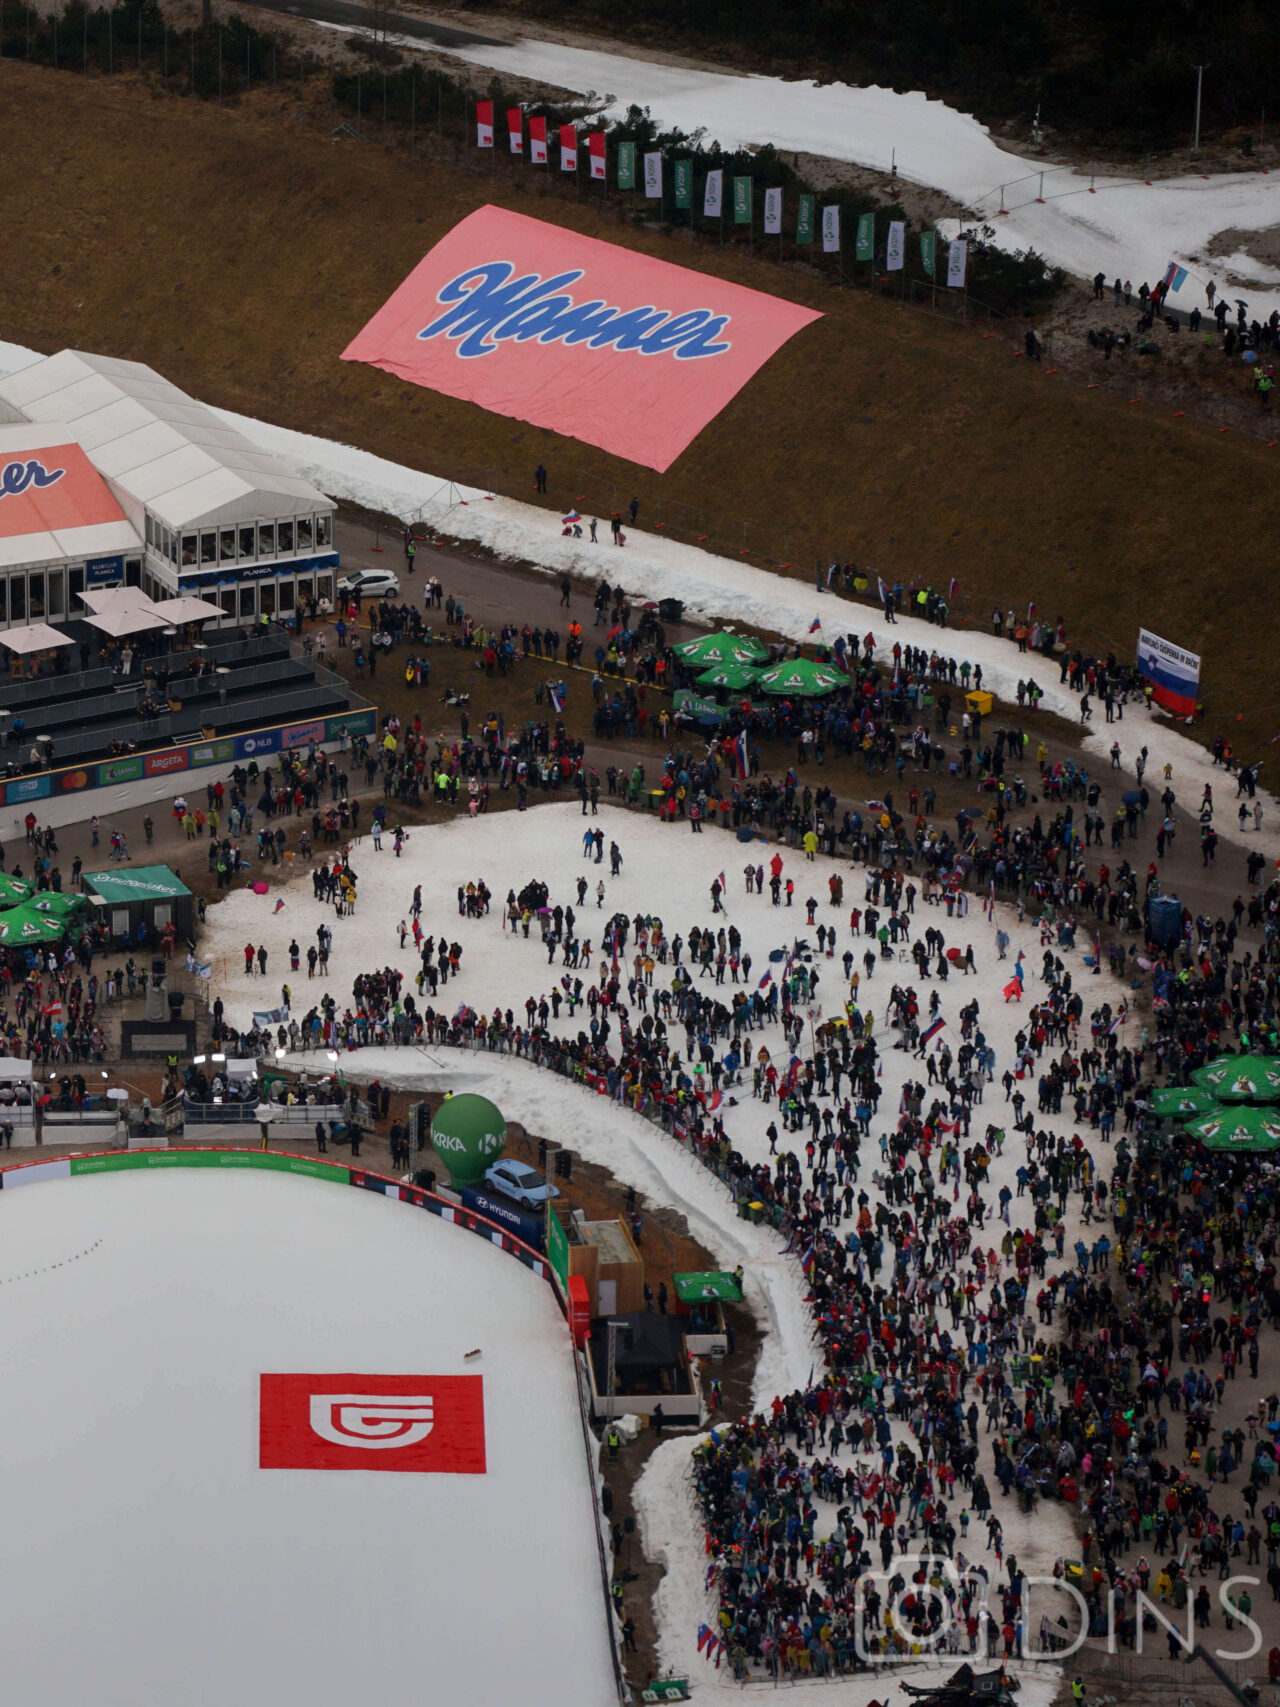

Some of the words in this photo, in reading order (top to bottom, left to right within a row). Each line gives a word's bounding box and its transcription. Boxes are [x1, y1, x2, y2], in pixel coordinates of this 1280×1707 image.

[417, 260, 732, 360] Manner
[244, 567, 272, 576] PLANICA
[257, 738, 272, 748] NLB
[151, 755, 183, 769] ARGETA
[433, 1129, 467, 1153] KRKA
[489, 1202, 521, 1226] HYUNDAI
